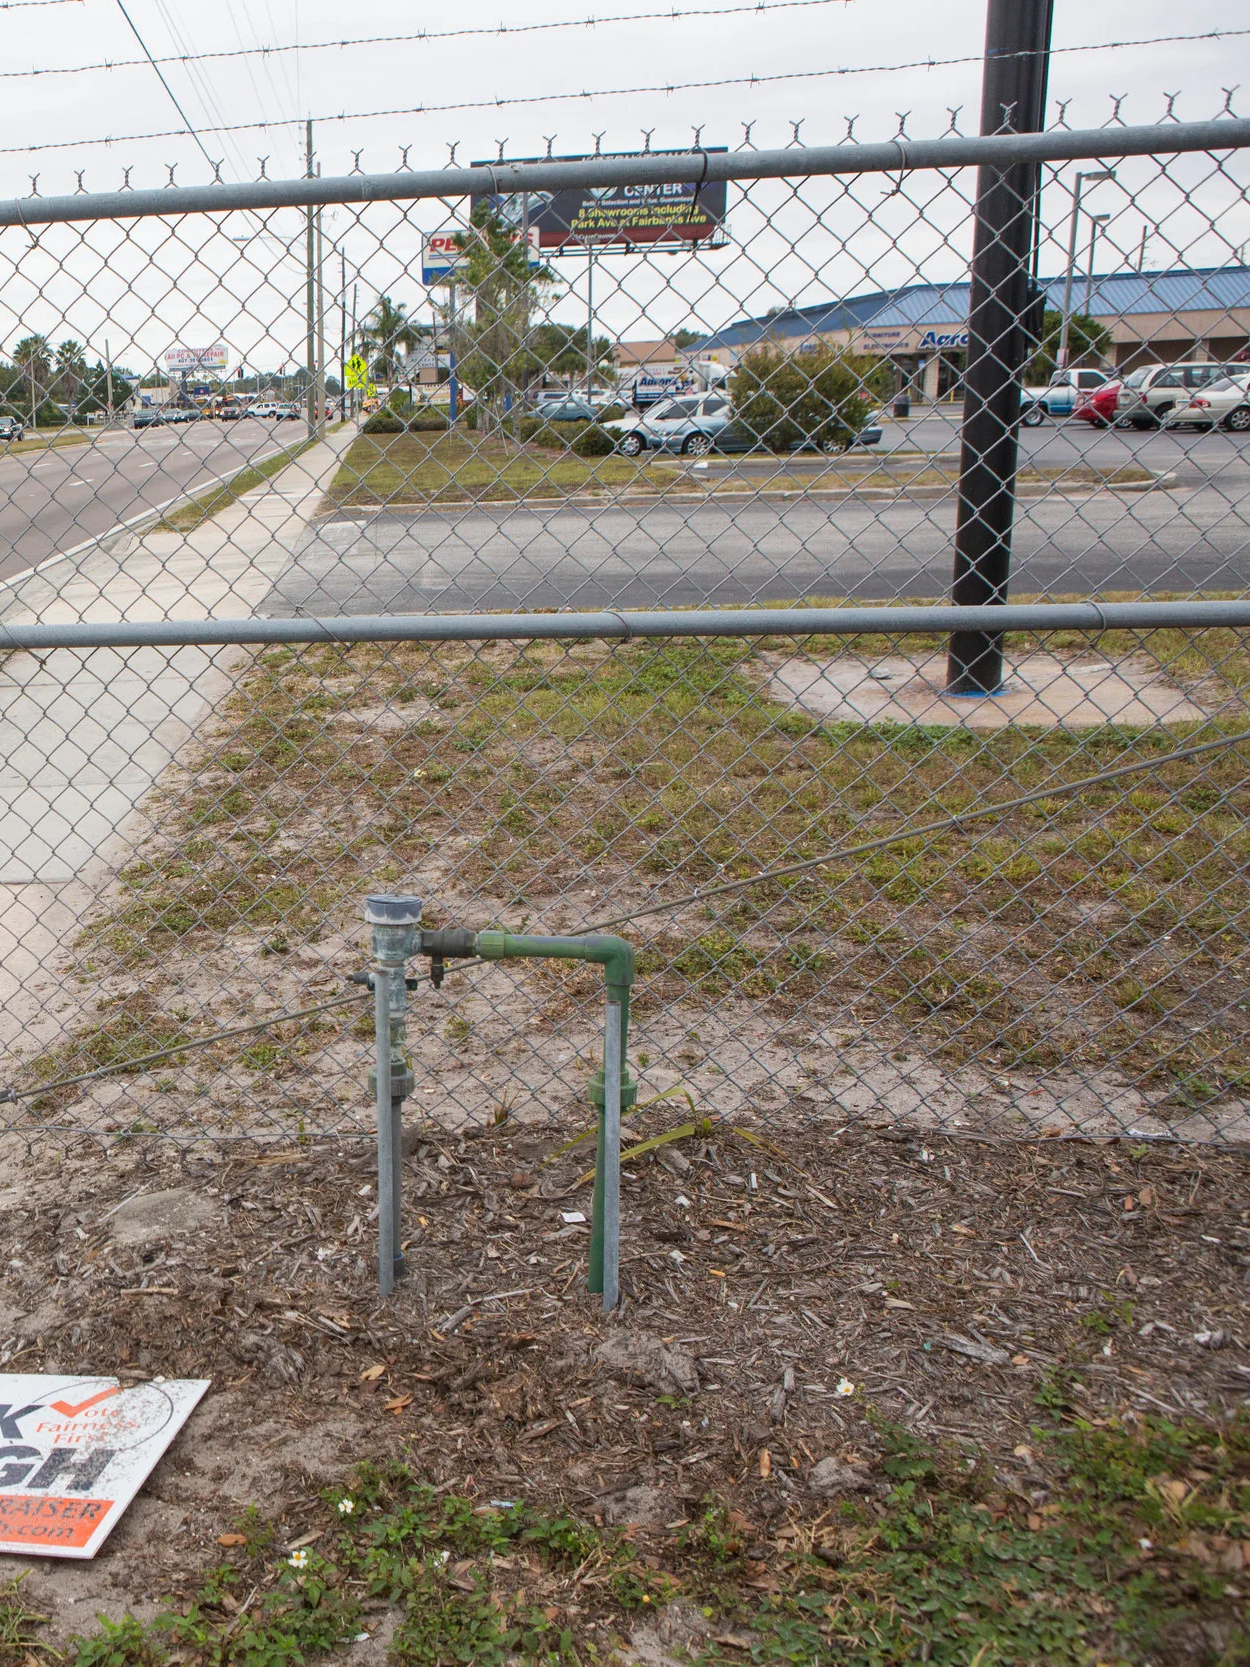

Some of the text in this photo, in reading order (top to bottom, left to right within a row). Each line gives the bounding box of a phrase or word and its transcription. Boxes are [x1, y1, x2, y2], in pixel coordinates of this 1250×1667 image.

[624, 183, 683, 197] CENTER
[579, 208, 586, 218] 8
[571, 218, 595, 229] Park
[631, 215, 684, 228] Fairbanks
[36, 1421, 137, 1433] Fairness
